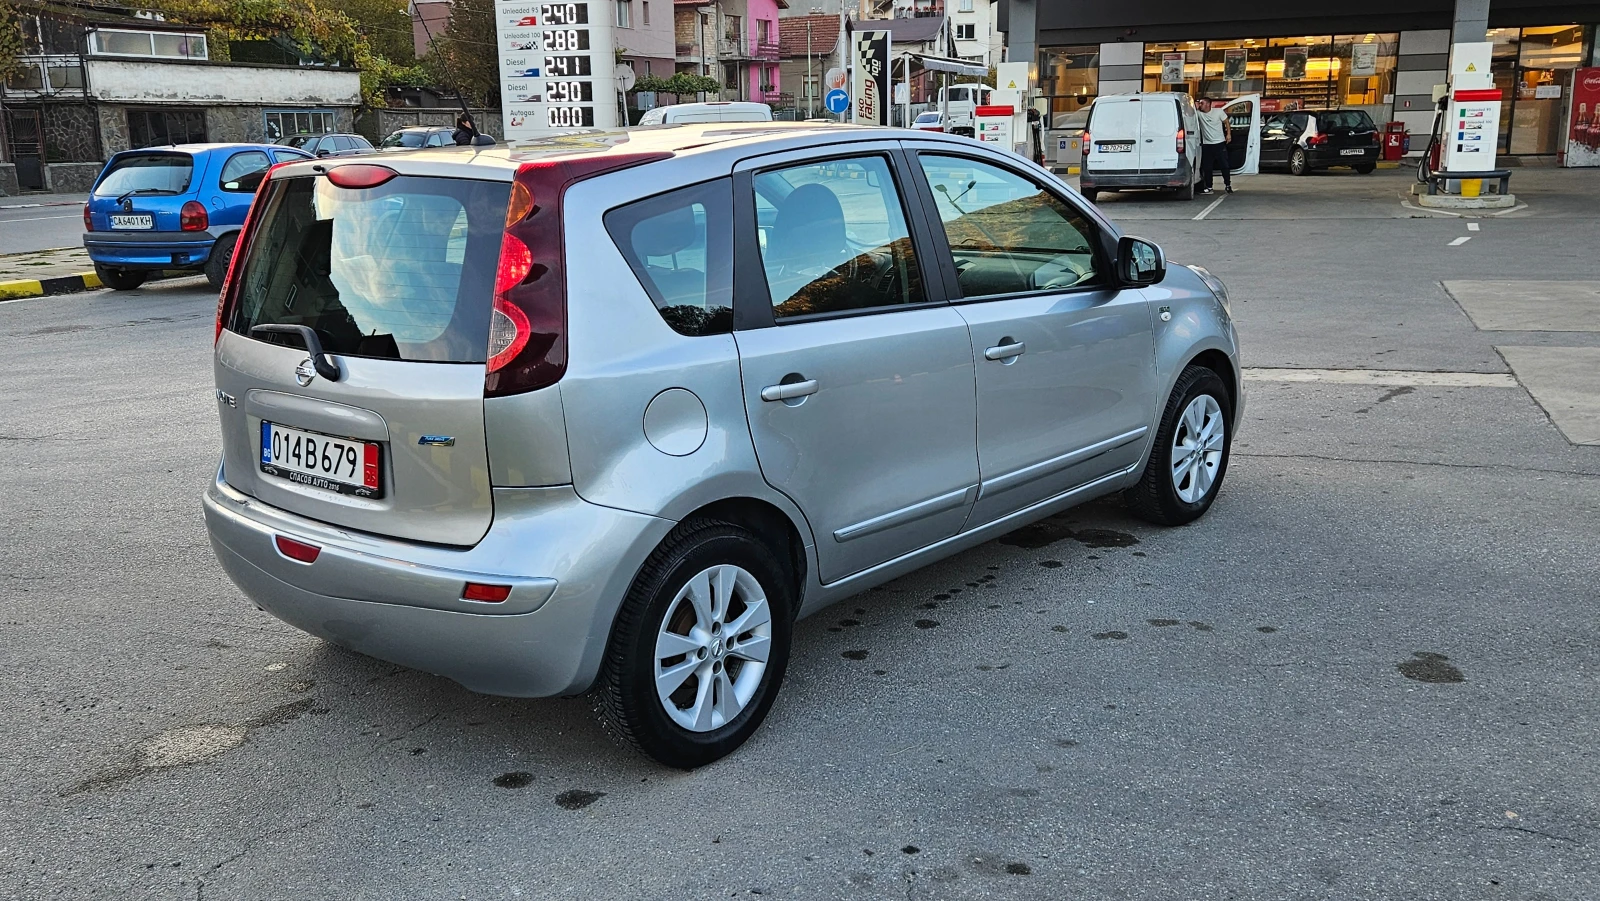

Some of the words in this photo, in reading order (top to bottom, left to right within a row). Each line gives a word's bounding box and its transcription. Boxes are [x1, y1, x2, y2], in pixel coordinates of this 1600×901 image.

[502, 7, 530, 15] Unleaded
[542, 3, 577, 25] 2.40
[504, 32, 530, 40] Unleaded
[543, 29, 579, 51] 2.88
[506, 58, 526, 66] Diesel
[545, 56, 580, 77] 2.41
[871, 59, 879, 77] 100
[546, 81, 582, 102] 2.90
[864, 79, 876, 120] racing
[510, 109, 535, 117] Autogas
[548, 107, 583, 127] 0.00
[263, 447, 271, 458] BG
[272, 430, 357, 478] 014B679
[289, 472, 312, 484] СПАСОВ
[312, 478, 328, 488] АУТО
